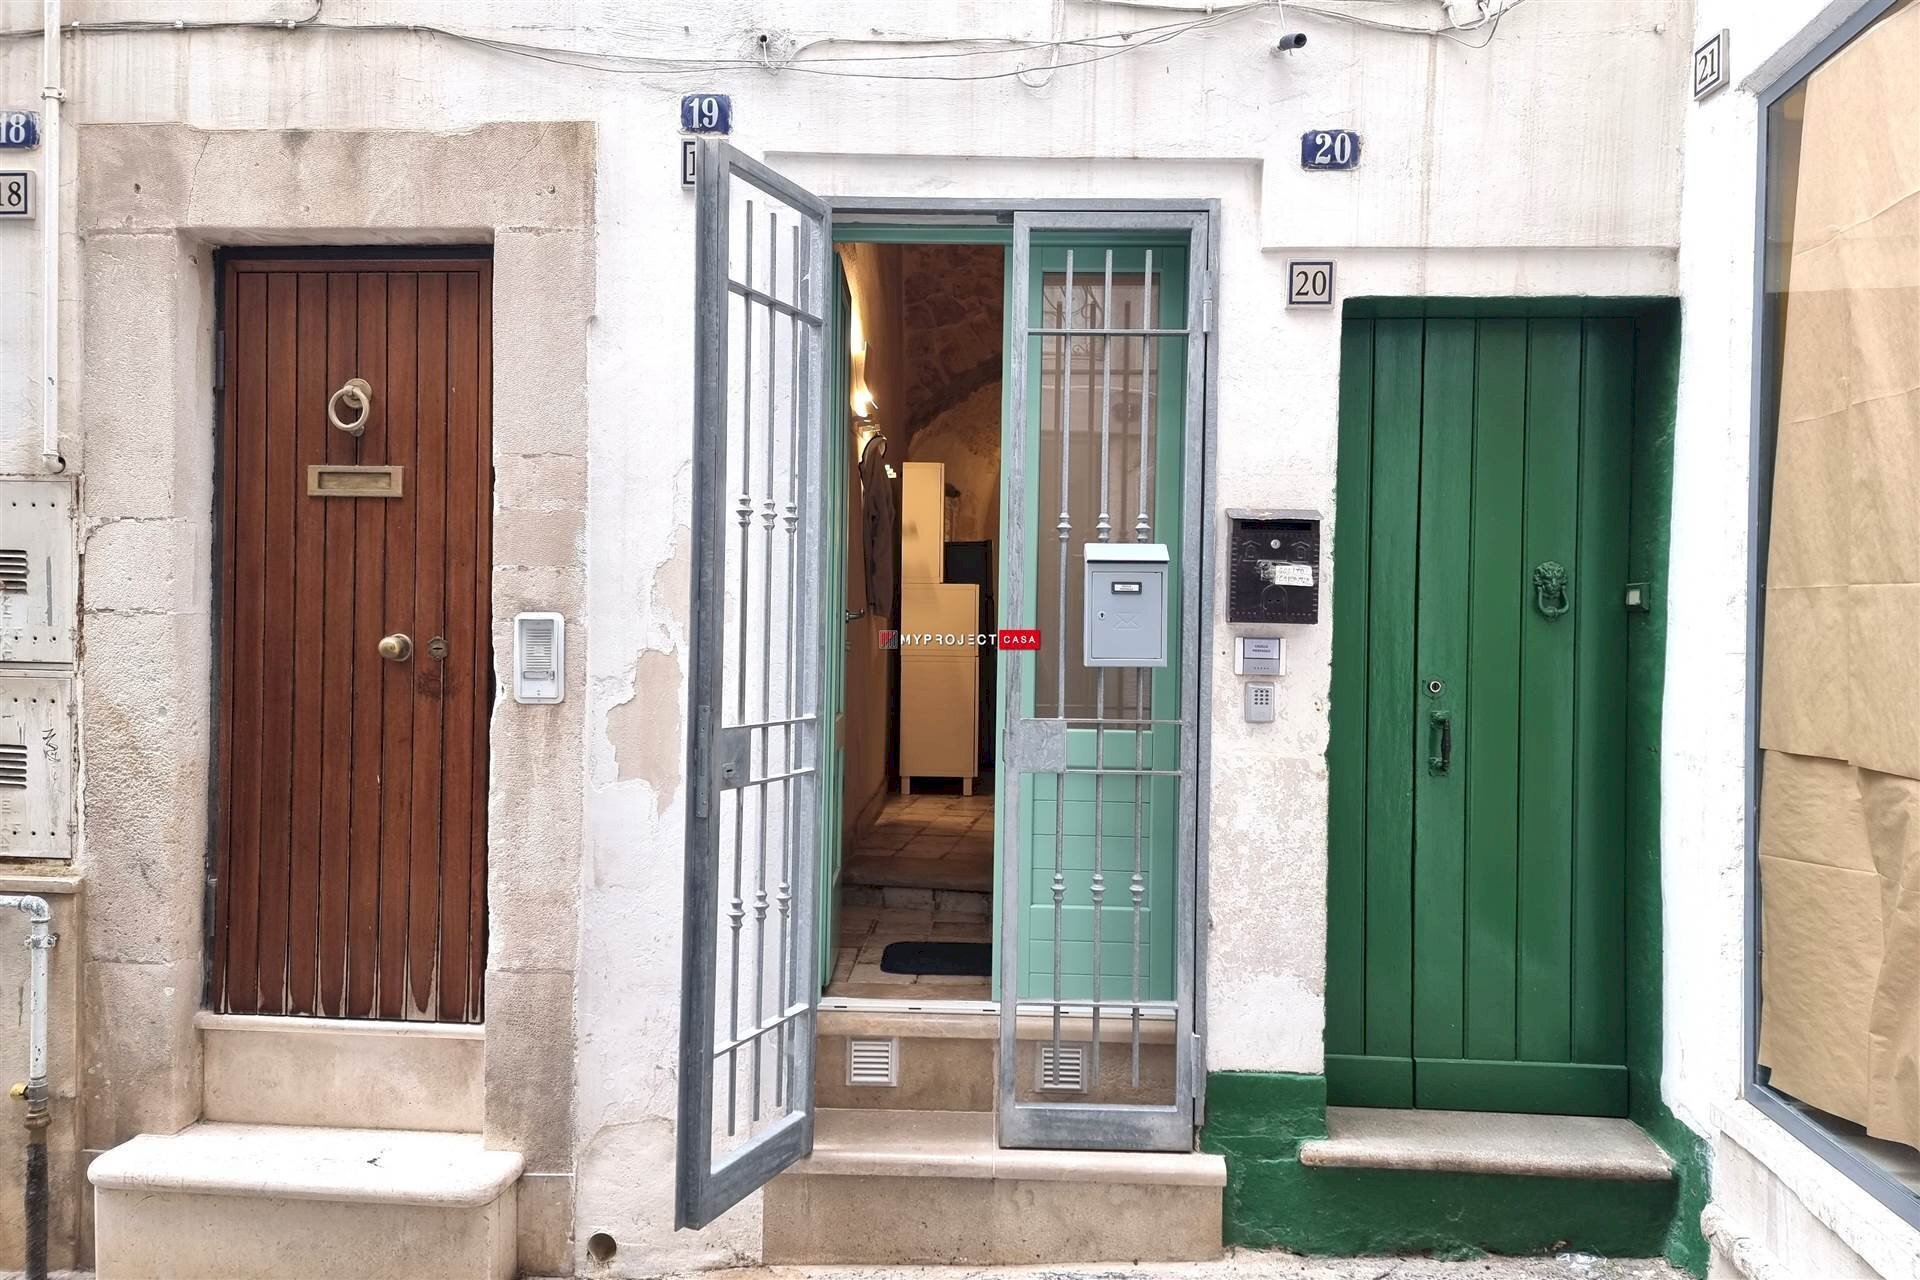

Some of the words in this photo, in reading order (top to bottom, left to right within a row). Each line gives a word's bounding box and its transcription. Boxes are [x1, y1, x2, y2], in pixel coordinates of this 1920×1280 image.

[1698, 48, 1717, 85] 21
[689, 97, 719, 128] 19
[688, 151, 696, 176] 1
[1315, 132, 1351, 165] 20
[1295, 270, 1327, 297] 20
